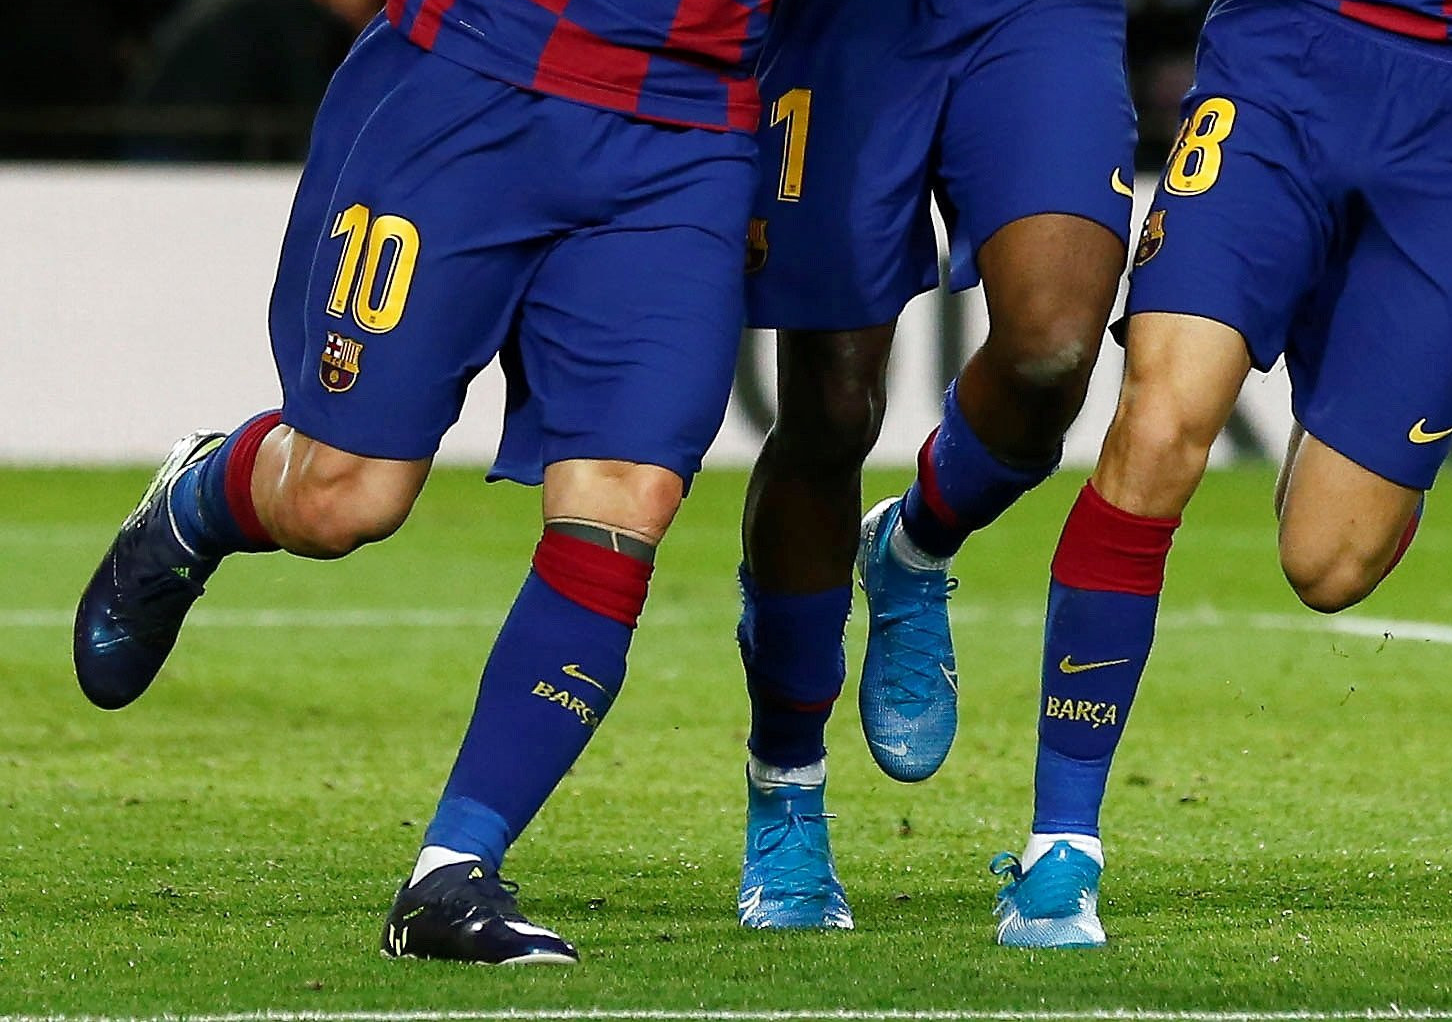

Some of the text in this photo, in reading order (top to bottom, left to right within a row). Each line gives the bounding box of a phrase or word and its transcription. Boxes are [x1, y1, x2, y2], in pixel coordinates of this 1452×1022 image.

[1164, 96, 1238, 197] 8
[326, 203, 421, 334] 10
[1046, 695, 1117, 728] BARÇA
